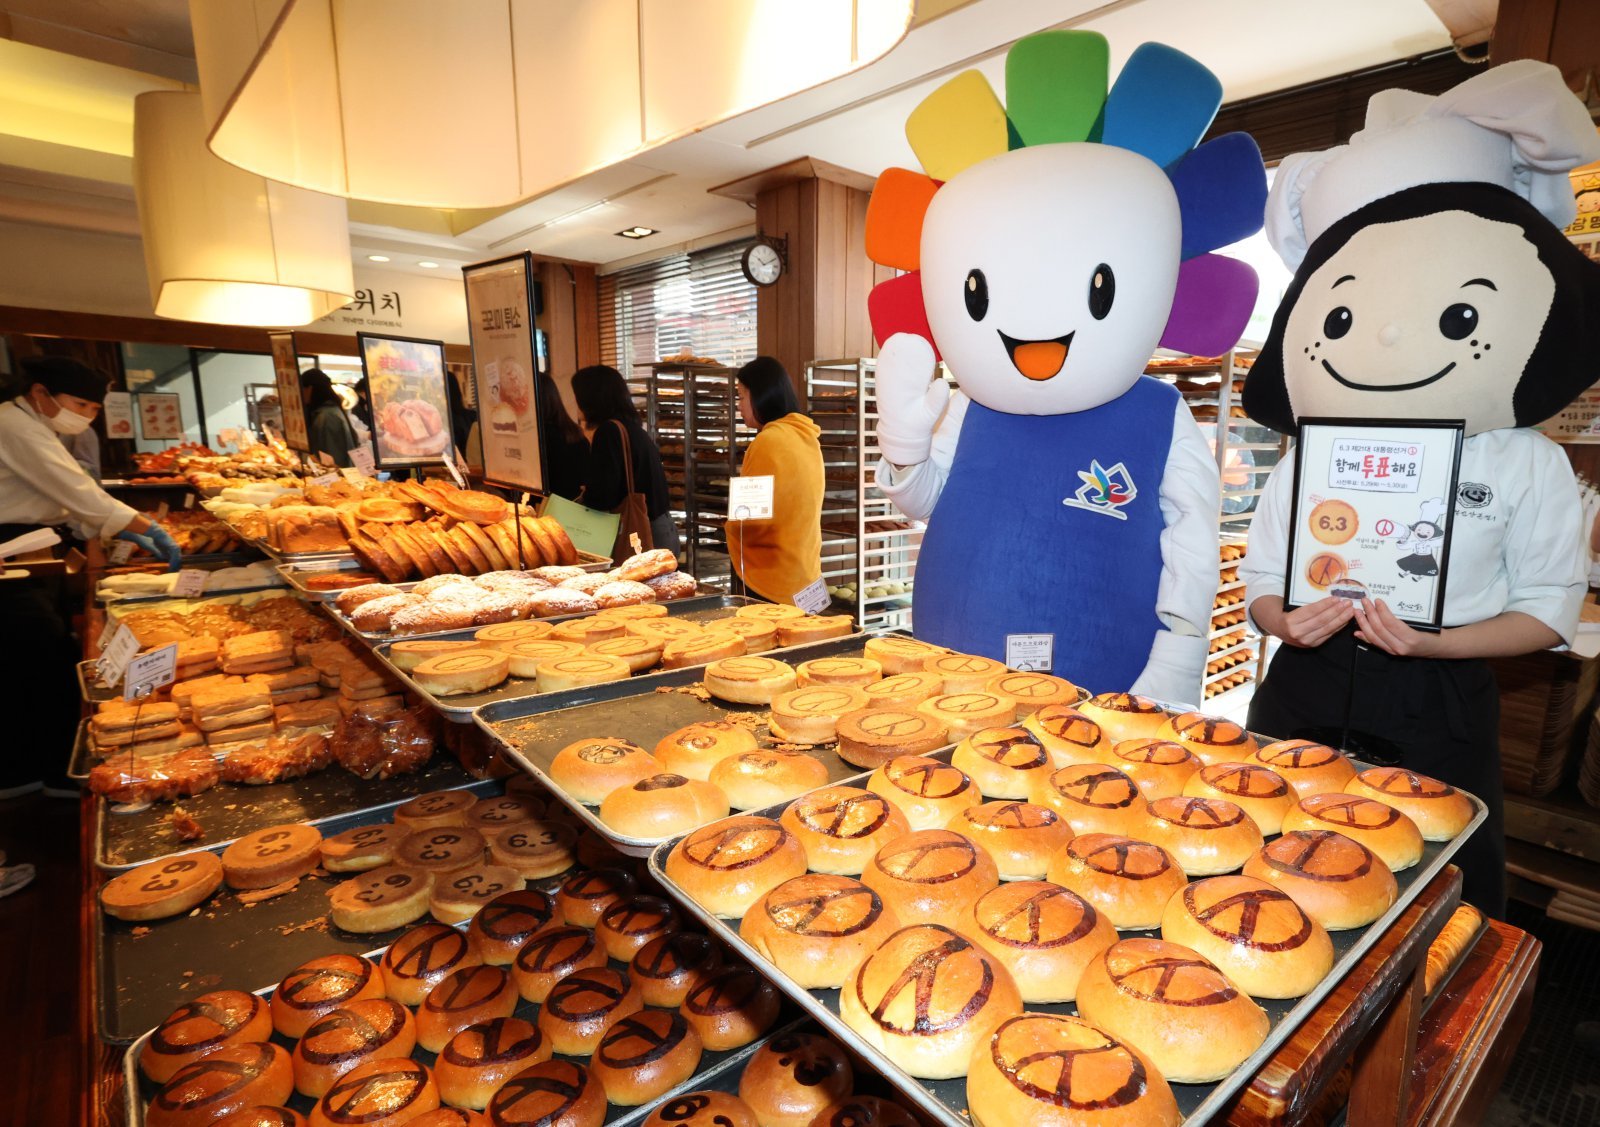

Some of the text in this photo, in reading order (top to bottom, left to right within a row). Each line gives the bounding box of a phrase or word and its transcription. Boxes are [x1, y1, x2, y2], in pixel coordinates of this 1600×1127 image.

[340, 288, 402, 318] 위치
[1351, 445, 1371, 453] 제21대
[1373, 446, 1407, 454] 대통령선거
[1335, 458, 1360, 473] 함께
[1319, 515, 1347, 531] 6.3
[648, 622, 689, 636] 6.3
[418, 796, 455, 813] 6.3
[481, 801, 522, 821] 6.3
[256, 830, 292, 858] 6.3
[351, 828, 388, 849] 6.3
[419, 834, 461, 860] 6.3
[508, 831, 558, 848] 6.3
[141, 859, 198, 893] 6.3
[353, 873, 412, 903] 6.3
[453, 875, 504, 898] 6.3
